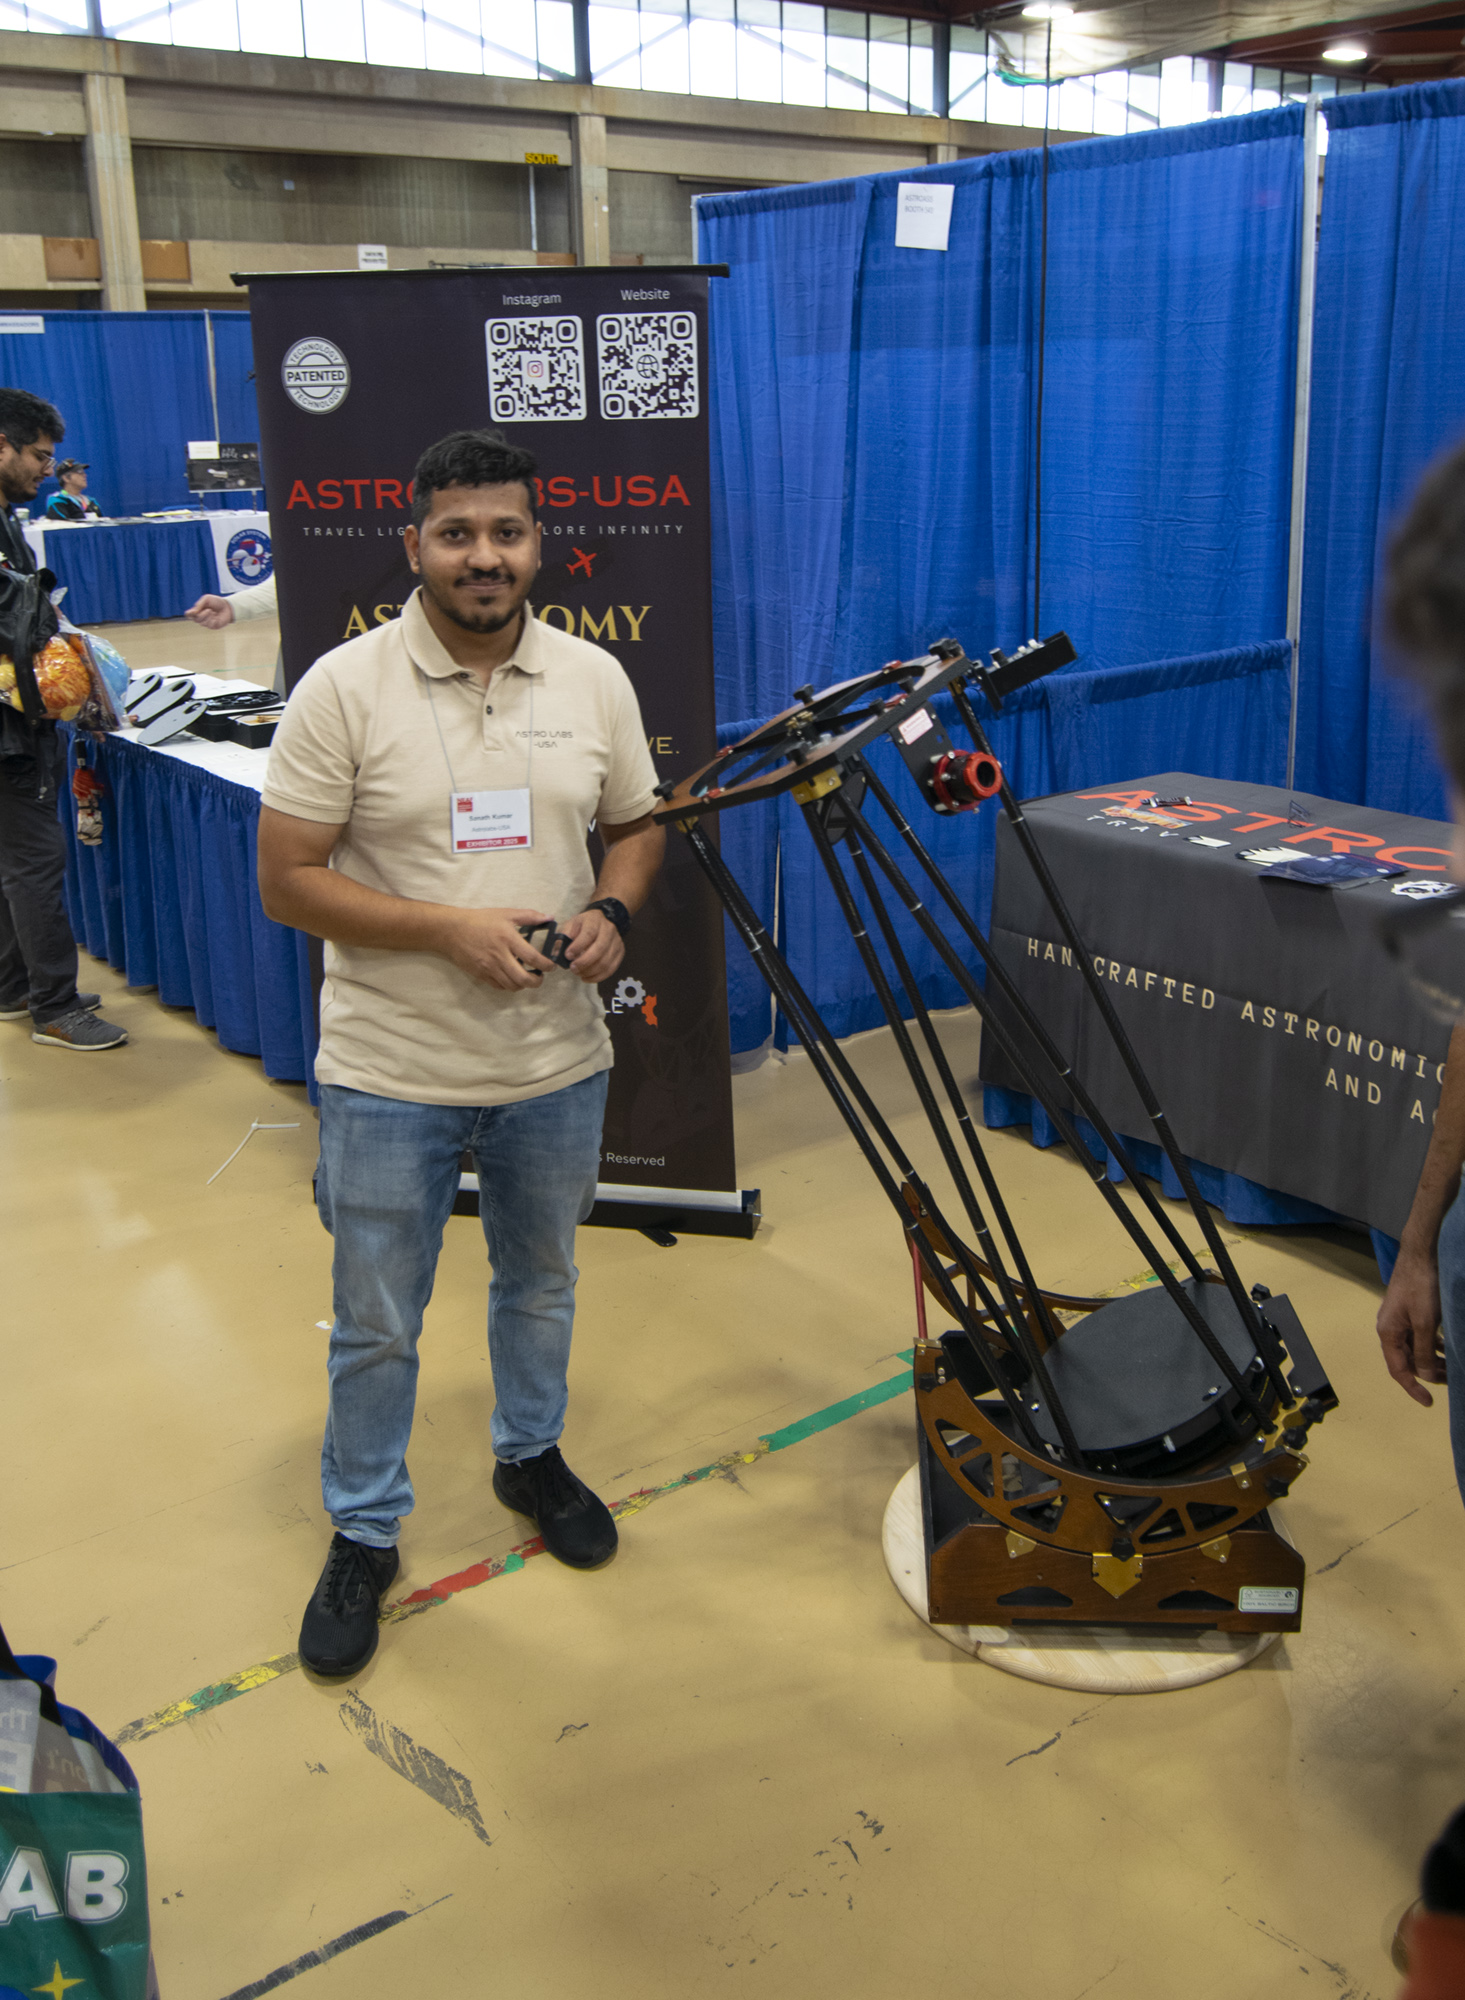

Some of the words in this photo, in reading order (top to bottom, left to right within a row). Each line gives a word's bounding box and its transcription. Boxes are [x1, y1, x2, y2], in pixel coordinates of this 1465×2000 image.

[525, 152, 558, 164] SOUTH
[502, 294, 562, 307] Instagram
[620, 288, 670, 301] Website
[290, 343, 340, 363] TECHNOLOGY
[286, 370, 345, 382] PATENTED
[294, 389, 341, 408] TECHNOLOGY
[286, 479, 415, 510] ASTR
[303, 527, 365, 536] TRAVEL
[377, 527, 406, 536] LIG
[542, 526, 587, 535] LORE
[599, 525, 684, 535] INFINITY
[1086, 814, 1179, 838] TRAV
[466, 840, 502, 848] EXHIBITOR
[1028, 937, 1215, 1010] HANCRAFTED
[1325, 1067, 1382, 1104] AND
[606, 1152, 665, 1166] Reserved
